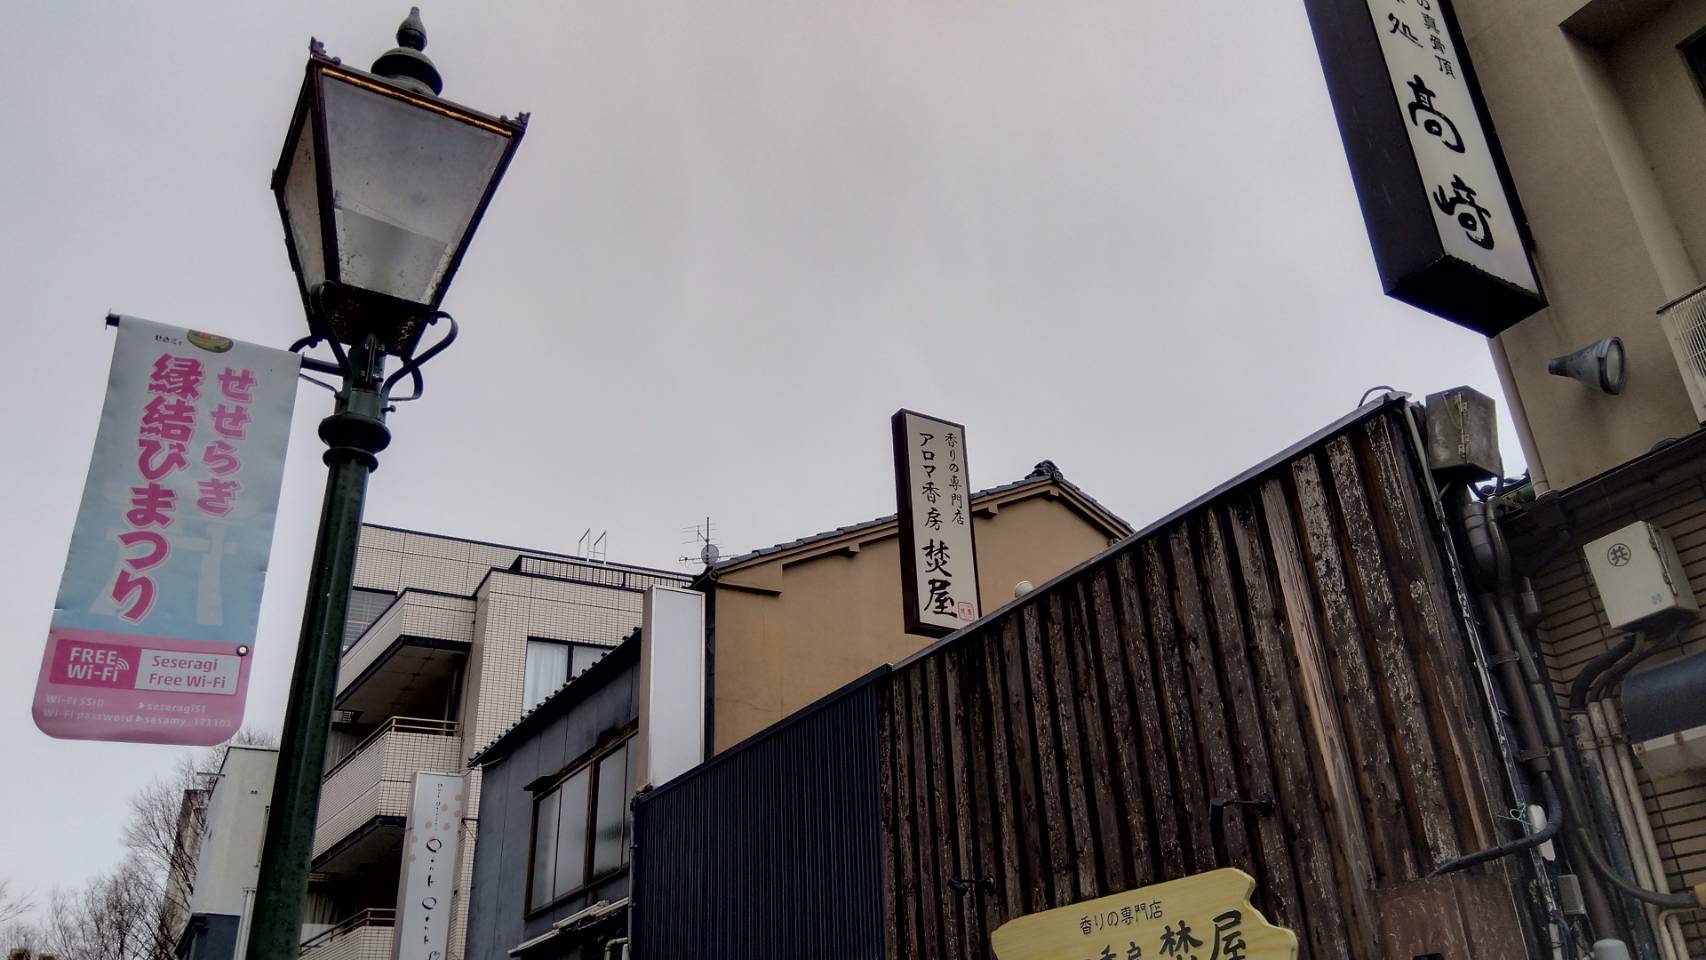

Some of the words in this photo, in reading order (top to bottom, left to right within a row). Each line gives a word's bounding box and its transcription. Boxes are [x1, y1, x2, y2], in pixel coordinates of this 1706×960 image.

[195, 366, 258, 517] せせらぎ
[111, 353, 204, 622] 縁結びまつり
[919, 432, 943, 531] アロマ香房
[944, 432, 964, 526] 香りの専門店
[921, 538, 958, 618] 焚屋
[67, 663, 119, 682] Wi-Fi
[69, 647, 118, 665] FREE
[152, 655, 218, 672] Seseragi
[149, 672, 183, 686] Free
[187, 675, 226, 688] Wi-Fi
[76, 712, 134, 722] password
[1079, 900, 1163, 935] 香りの専門店
